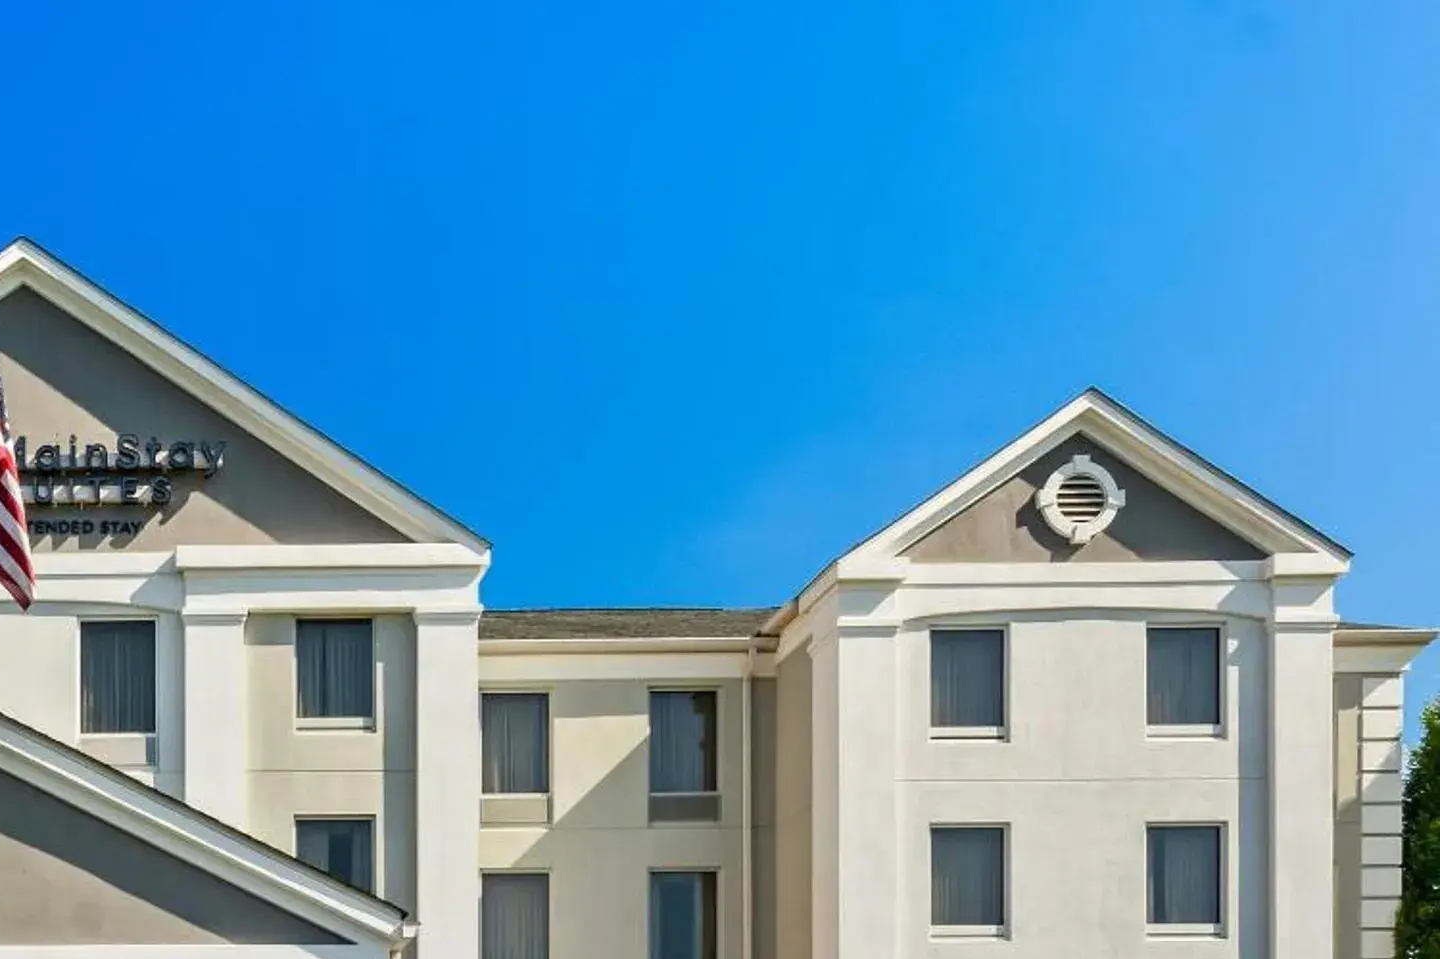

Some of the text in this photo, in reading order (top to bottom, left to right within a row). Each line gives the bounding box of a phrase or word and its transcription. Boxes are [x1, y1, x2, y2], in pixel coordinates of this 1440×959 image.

[34, 475, 171, 504] UITES
[27, 521, 141, 534] TENDED STAY
